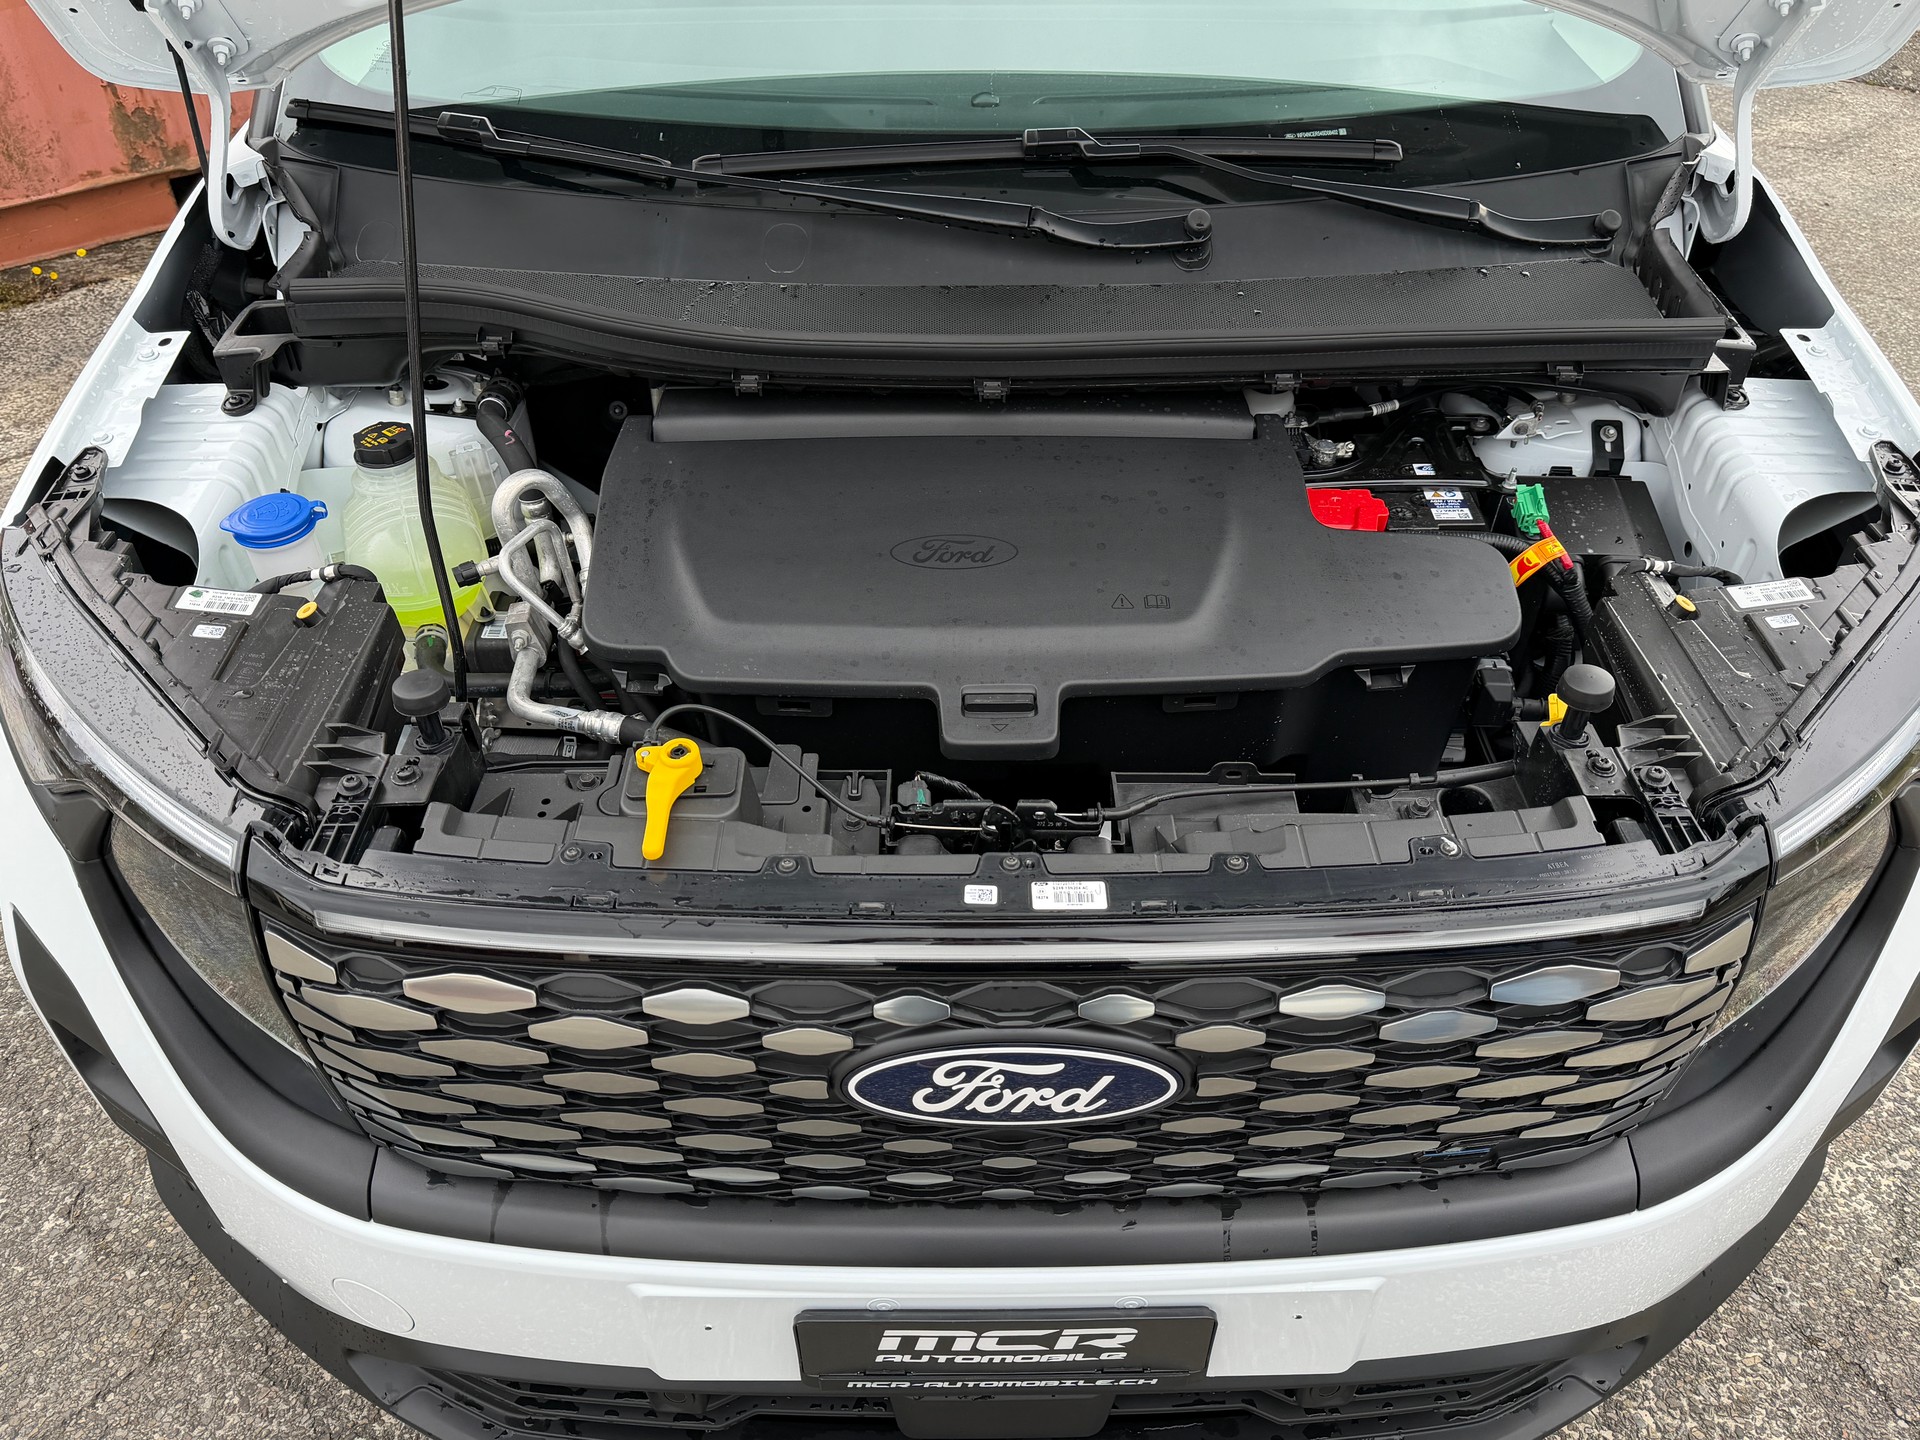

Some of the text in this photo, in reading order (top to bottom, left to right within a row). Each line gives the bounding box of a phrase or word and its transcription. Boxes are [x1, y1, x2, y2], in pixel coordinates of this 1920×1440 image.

[912, 538, 995, 563] Ford
[912, 1060, 1115, 1114] Ford
[877, 1327, 1139, 1351] MCR
[875, 1351, 1129, 1363] AUTOMOBILE
[846, 1378, 1158, 1388] MCR-AUTOMOBILE.CH
